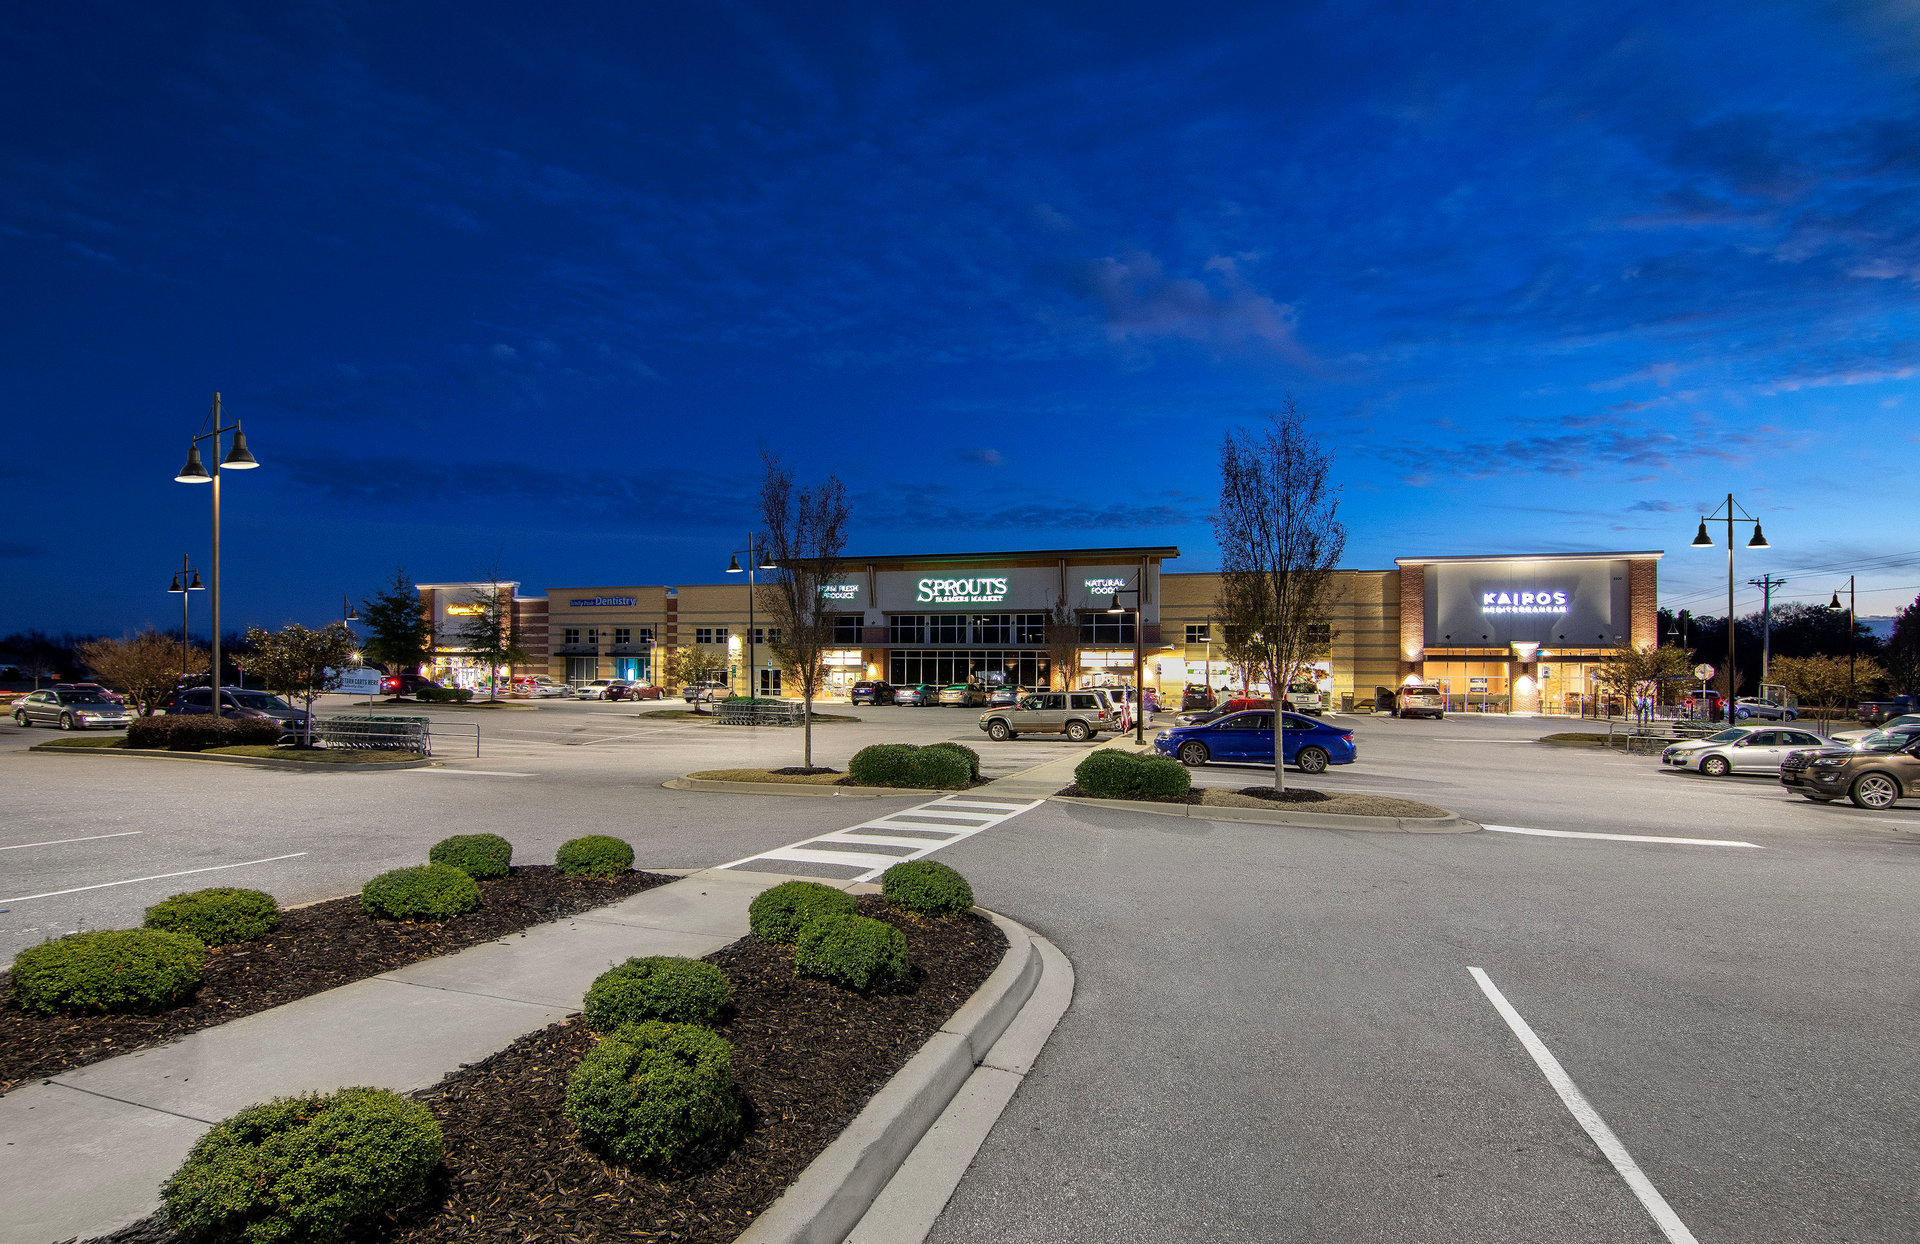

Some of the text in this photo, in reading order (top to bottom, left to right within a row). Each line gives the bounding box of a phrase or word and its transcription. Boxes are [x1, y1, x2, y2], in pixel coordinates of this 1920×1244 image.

[1085, 579, 1126, 587] NATURAL
[917, 578, 1008, 602] SPROUTS
[595, 597, 636, 606] Dentistry
[1483, 592, 1567, 605] KAIROS
